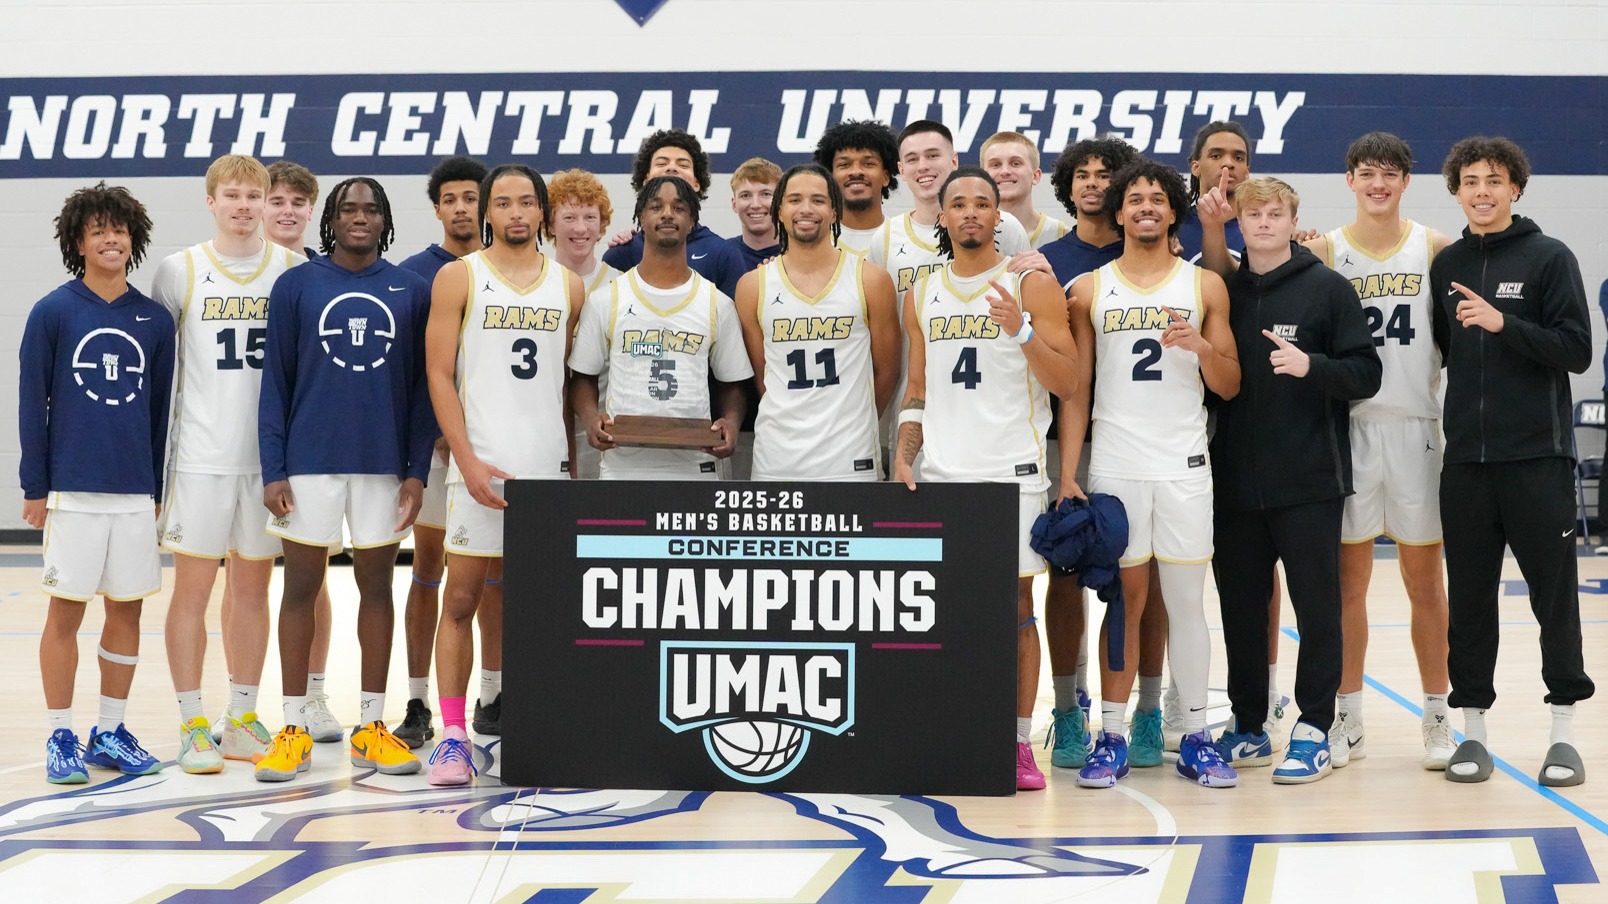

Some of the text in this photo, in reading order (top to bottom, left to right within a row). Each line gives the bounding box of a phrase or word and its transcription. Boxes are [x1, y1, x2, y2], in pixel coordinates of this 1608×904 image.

[0, 89, 1306, 160] NORTH CENTRAL UNIVERSITY
[1496, 282, 1524, 294] NCU
[202, 296, 269, 321] RAM
[483, 305, 562, 332] RAMS
[350, 329, 364, 346] U
[772, 316, 855, 342] RAMS
[930, 314, 1000, 342] RAMS
[1272, 324, 1298, 337] NCU
[1363, 304, 1415, 347] 24
[216, 327, 266, 370] 15
[511, 337, 538, 380] 3
[633, 345, 660, 356] UMAC
[1131, 337, 1163, 382] 2
[105, 365, 118, 381] U
[648, 359, 678, 401] 5
[786, 347, 841, 390] 11
[951, 346, 982, 390] 4
[714, 490, 805, 509] 2025-26
[655, 512, 864, 533] MEN'S BASKETBALL
[667, 538, 851, 558] CONFERENCE
[581, 566, 937, 633] CHAMPIONS
[672, 653, 842, 723] UMAC
